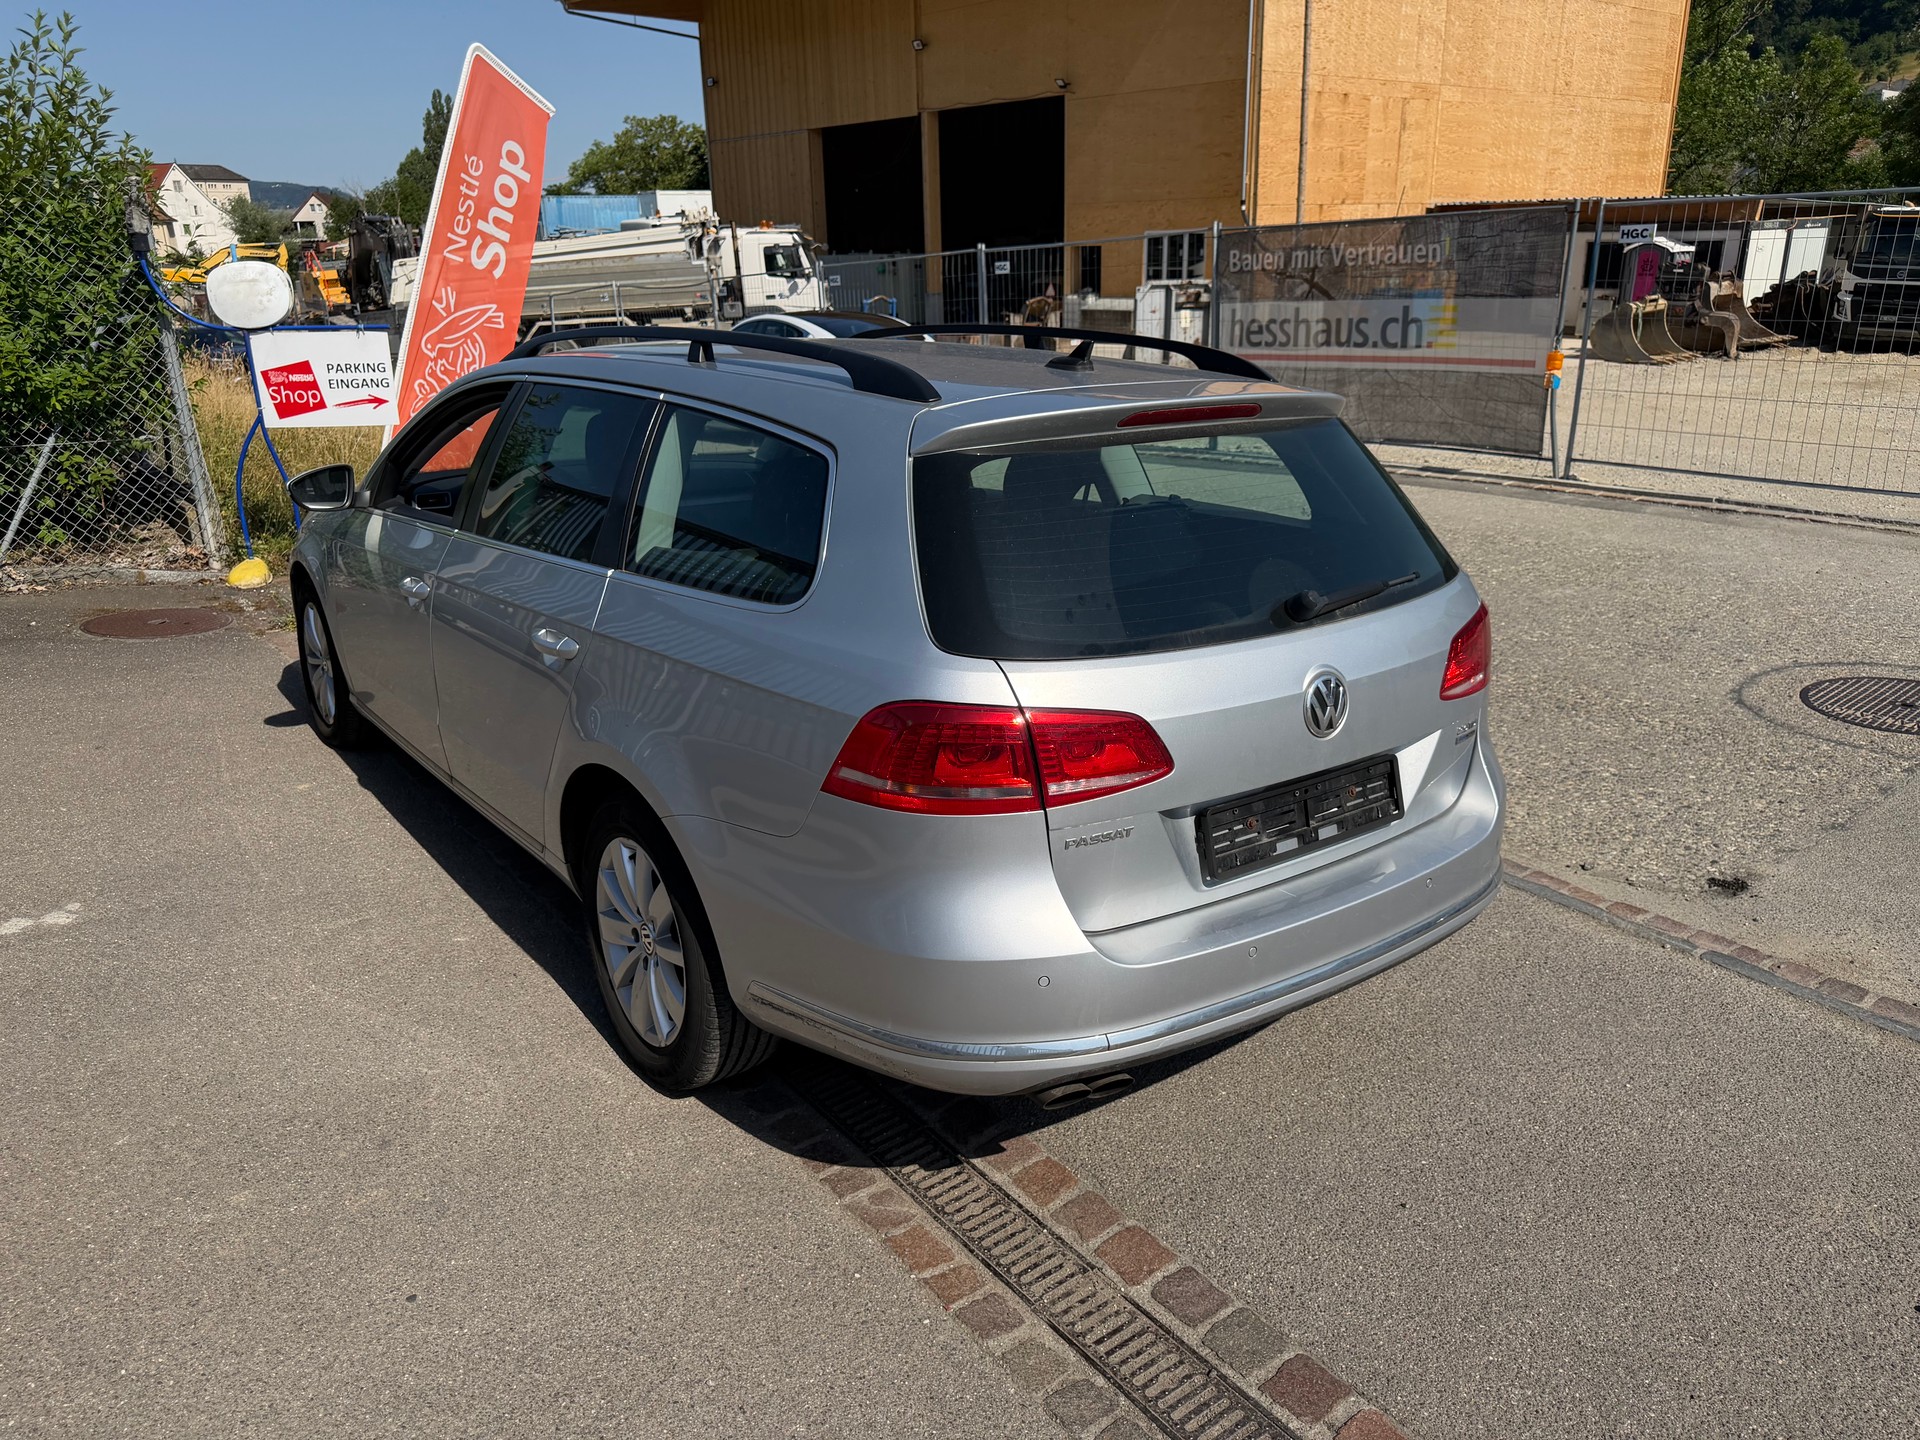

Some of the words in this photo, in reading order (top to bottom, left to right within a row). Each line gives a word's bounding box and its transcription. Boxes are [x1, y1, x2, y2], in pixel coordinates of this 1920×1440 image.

[443, 153, 483, 263] Nestlé
[470, 140, 532, 280] Shop
[1621, 228, 1650, 240] HGC
[1229, 249, 1285, 274] Bauen
[1291, 246, 1325, 270] mit
[1229, 305, 1423, 350] hesshaus.ch
[326, 362, 387, 374] PARKING
[328, 378, 390, 390] EINGANG
[269, 386, 320, 407] Shop
[1064, 826, 1135, 850] PASSAT
